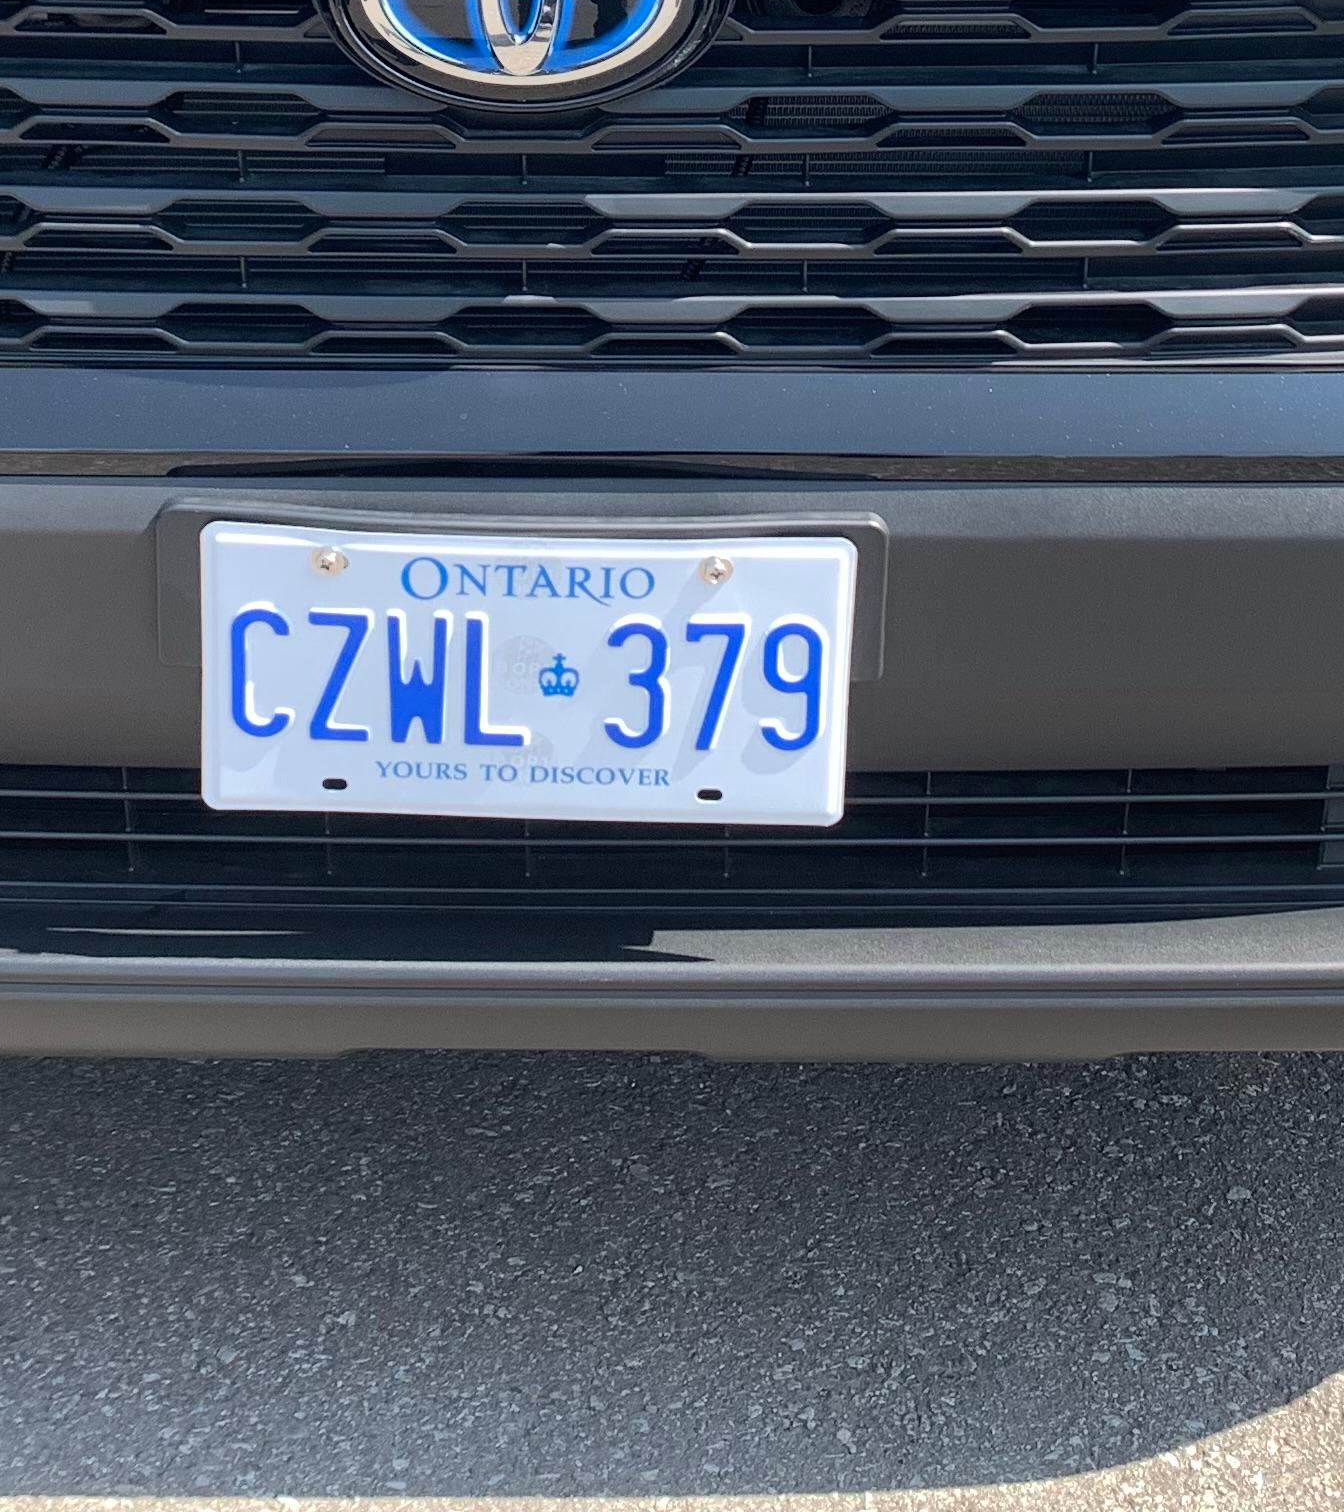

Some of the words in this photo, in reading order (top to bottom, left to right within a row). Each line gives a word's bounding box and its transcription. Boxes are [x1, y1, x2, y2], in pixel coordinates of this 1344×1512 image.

[401, 556, 656, 607] ONTARIO
[230, 601, 532, 748] CZWL
[603, 614, 828, 752] 379
[375, 760, 468, 781] YOURS
[479, 763, 518, 783] TO
[529, 765, 671, 787] DISCOVER
